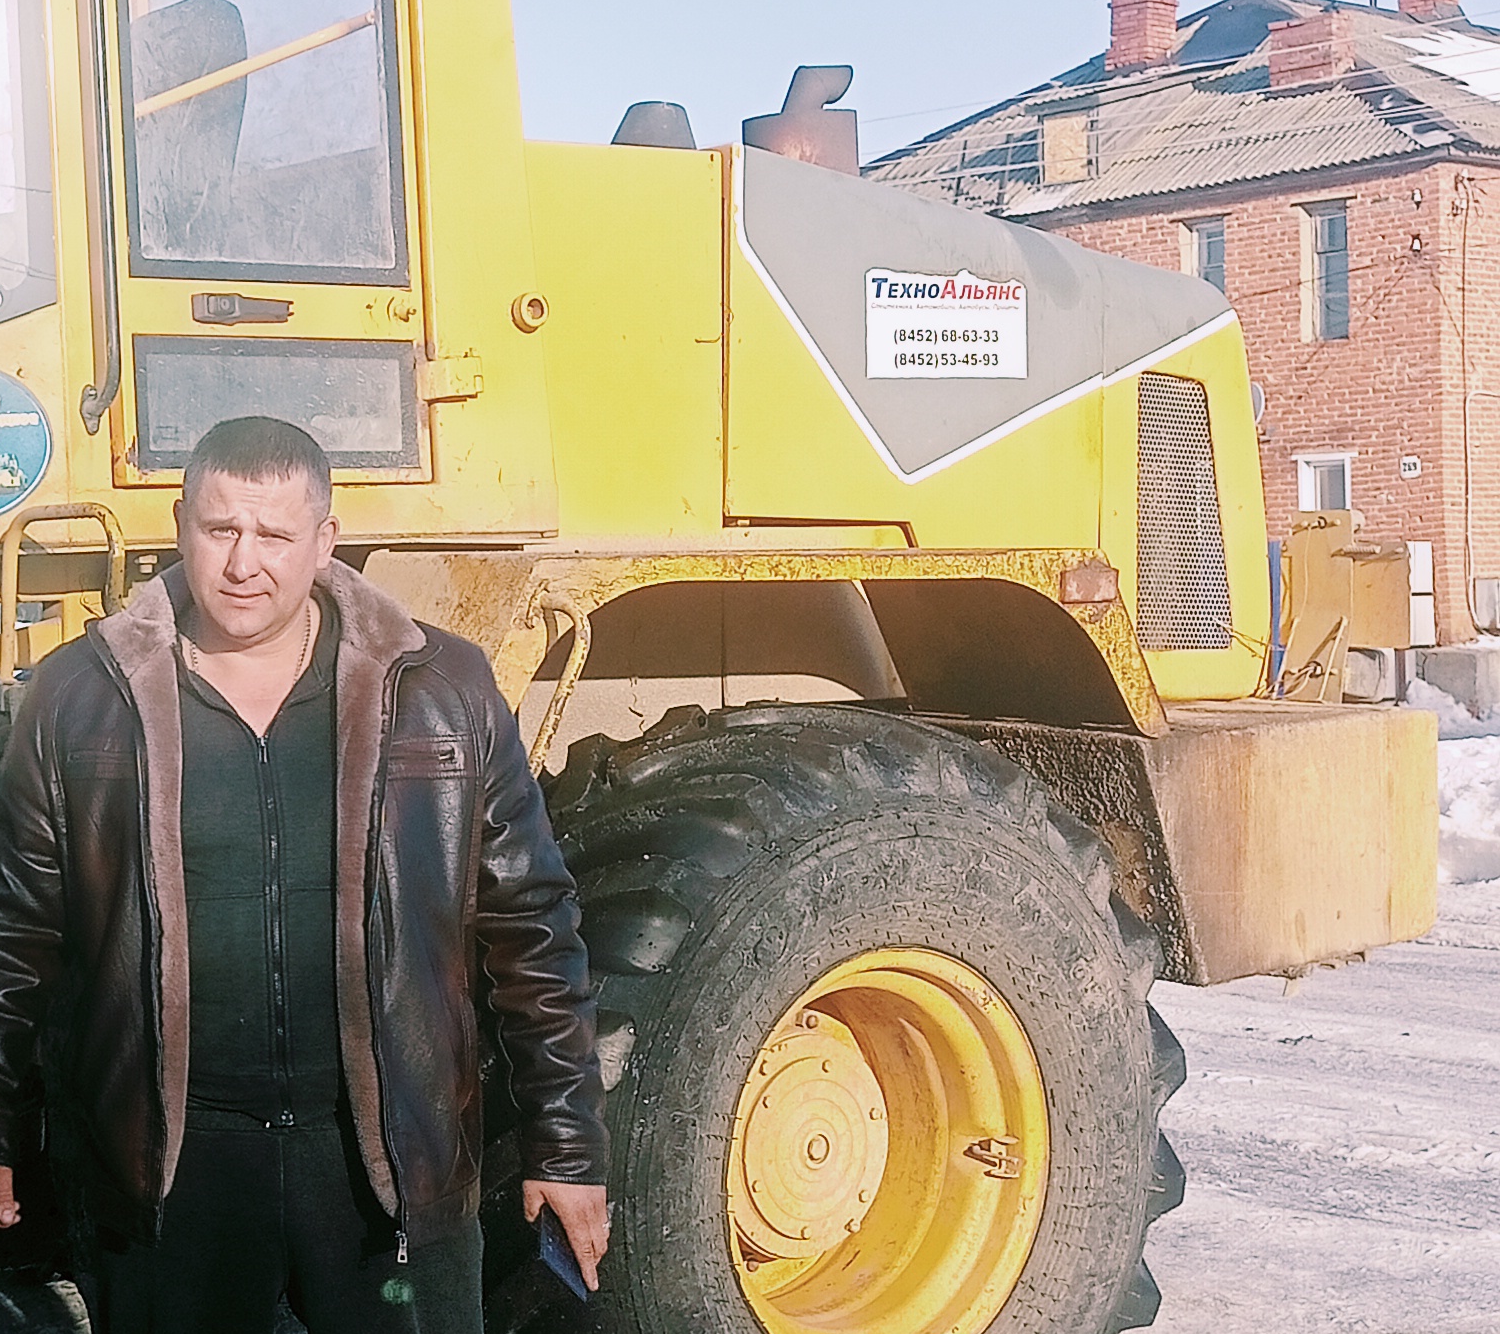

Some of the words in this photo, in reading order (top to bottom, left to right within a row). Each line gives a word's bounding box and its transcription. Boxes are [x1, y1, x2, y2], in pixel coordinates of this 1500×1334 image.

[893, 329, 938, 345] (8452)
[941, 329, 999, 342] 68-63-33
[894, 353, 938, 369] (8452)
[940, 353, 999, 366] 53-45-93
